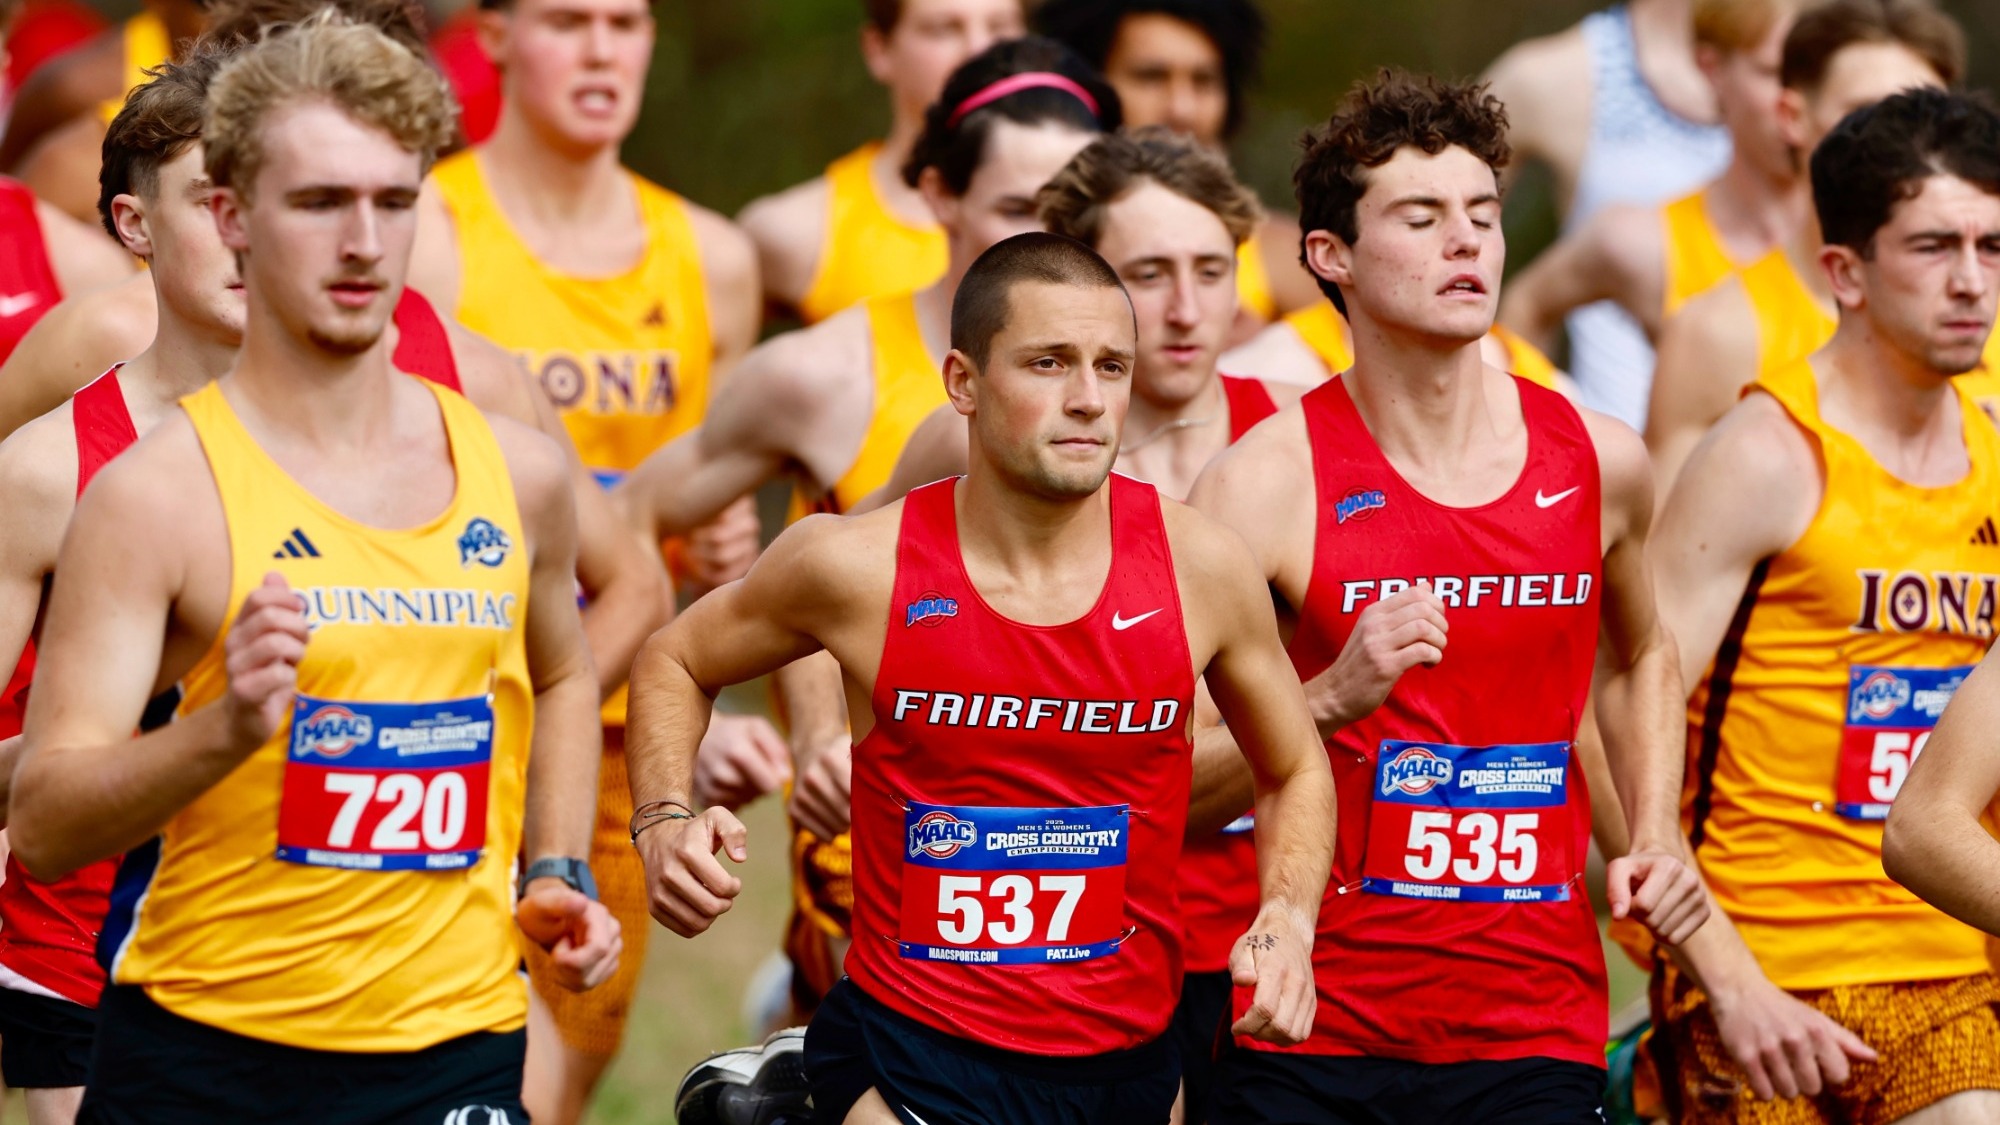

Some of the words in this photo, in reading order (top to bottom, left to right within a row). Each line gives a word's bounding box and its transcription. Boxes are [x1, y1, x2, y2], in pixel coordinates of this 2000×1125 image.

[518, 352, 676, 413] ONA
[1335, 490, 1386, 524] MAAC
[1341, 573, 1592, 614] FARFIELD
[907, 598, 958, 627] MAAC
[893, 689, 1180, 734] FAIRFIELD
[294, 714, 373, 757] MAAC
[1381, 757, 1453, 796] MAAC
[1459, 770, 1506, 788] CROSS
[1507, 767, 1564, 786] COUNTRY
[324, 771, 468, 850] 720
[910, 821, 977, 857] MAAC
[986, 832, 1039, 851] CROSS
[1041, 829, 1120, 847] COUNTRY
[1010, 846, 1096, 855] CHAMPIONSHIPS
[1404, 811, 1539, 883] 535
[937, 874, 1086, 945] 537
[1503, 887, 1541, 900] FAT.Live
[929, 947, 998, 962] MAACSPORTS.COM
[1046, 948, 1090, 960] FAT.Live
